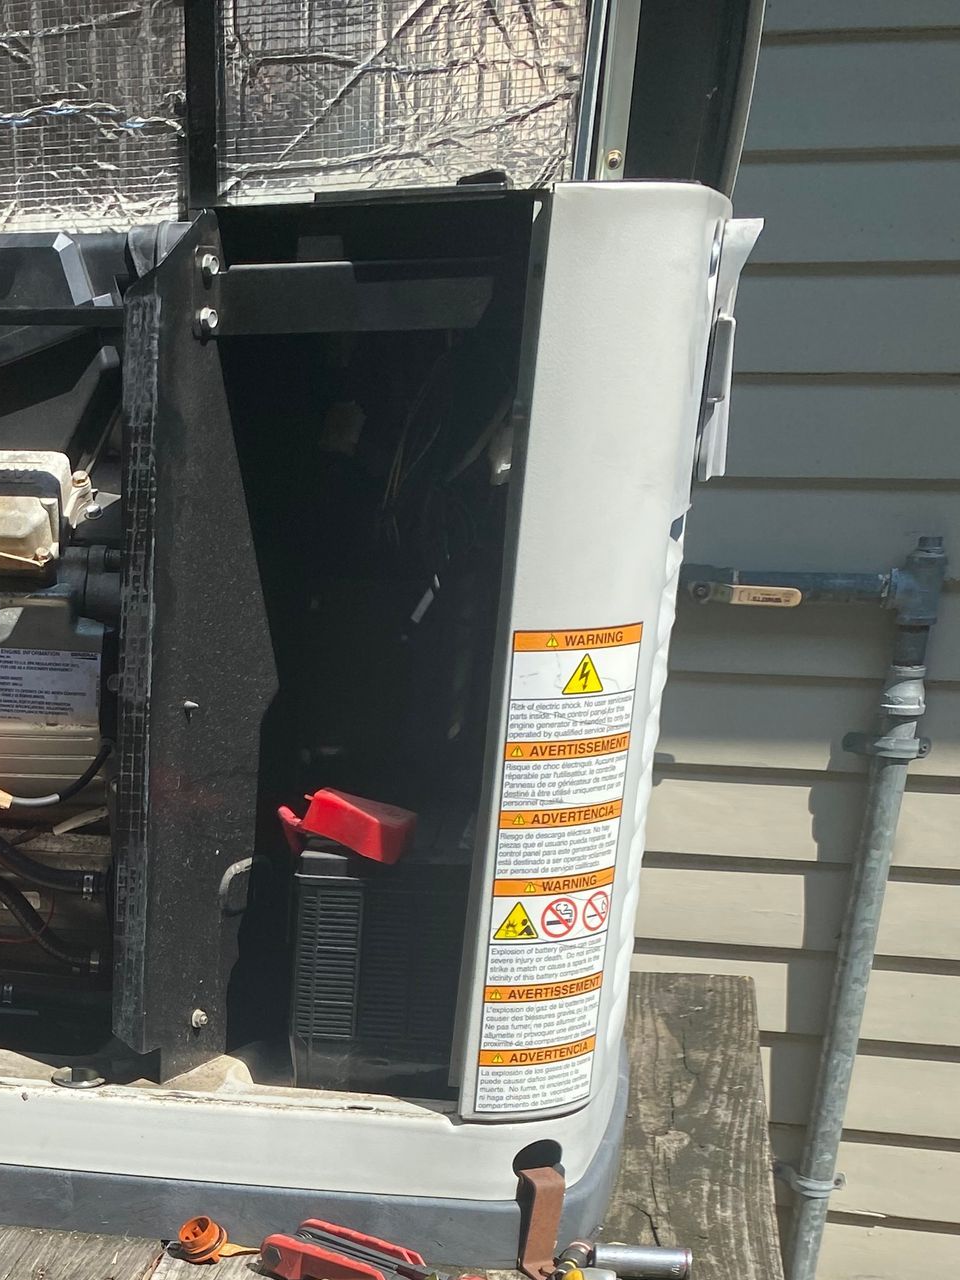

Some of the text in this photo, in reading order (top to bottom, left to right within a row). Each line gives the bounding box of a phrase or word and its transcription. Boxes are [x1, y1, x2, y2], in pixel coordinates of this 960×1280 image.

[565, 631, 624, 647] WARNING
[510, 713, 527, 721] parts
[509, 722, 535, 731] engine
[536, 721, 570, 730] generator
[509, 731, 542, 739] operated
[543, 731, 553, 739] by
[529, 735, 628, 757] AVERTISSEMENT
[506, 763, 530, 772] Risque
[531, 805, 615, 825] ADVERTENCIA
[542, 875, 597, 891] WARNING
[491, 948, 525, 956] Explosion
[534, 946, 558, 954] battery
[508, 976, 601, 1000] AVERTISSEMENT
[509, 1041, 589, 1063] ADVERTENCIA
